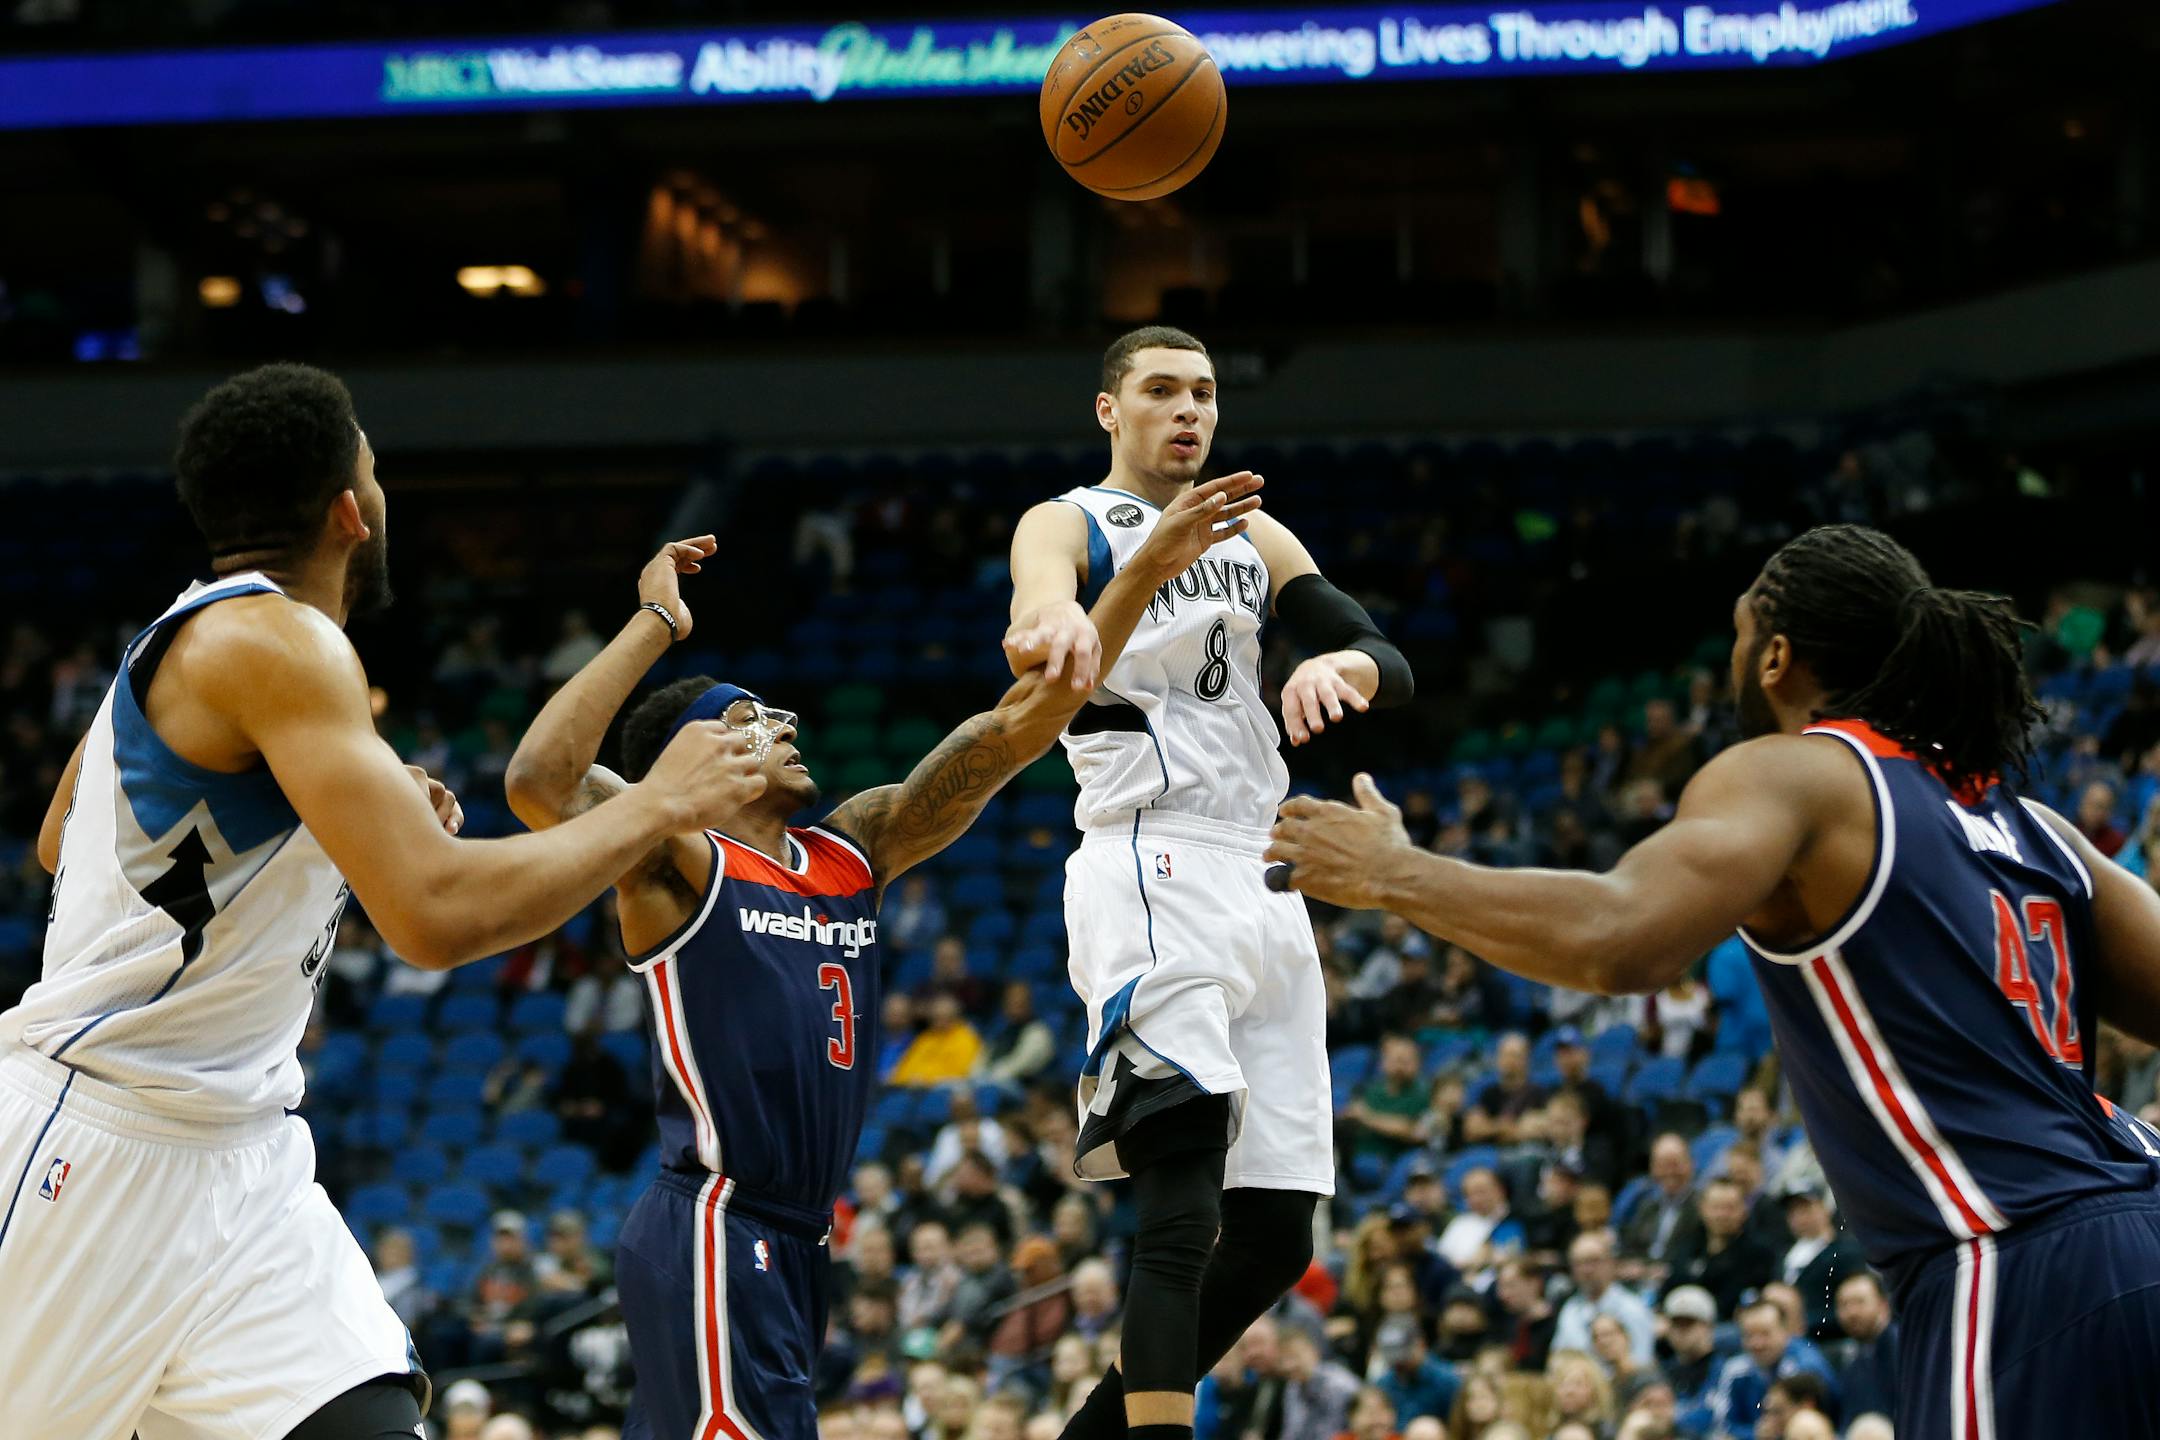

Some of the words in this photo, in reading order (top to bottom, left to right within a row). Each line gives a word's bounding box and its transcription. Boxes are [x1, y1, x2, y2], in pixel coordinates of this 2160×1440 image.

[690, 38, 845, 100] Ability
[1202, 21, 1375, 77] owering
[1379, 17, 1492, 64] Lives
[1490, 7, 1678, 67] Through
[1064, 40, 1175, 141] SPALDING
[1110, 508, 1138, 523] FLIP
[1194, 618, 1231, 701] 8
[817, 962, 855, 1071] 3
[1989, 888, 2083, 1070] 42
